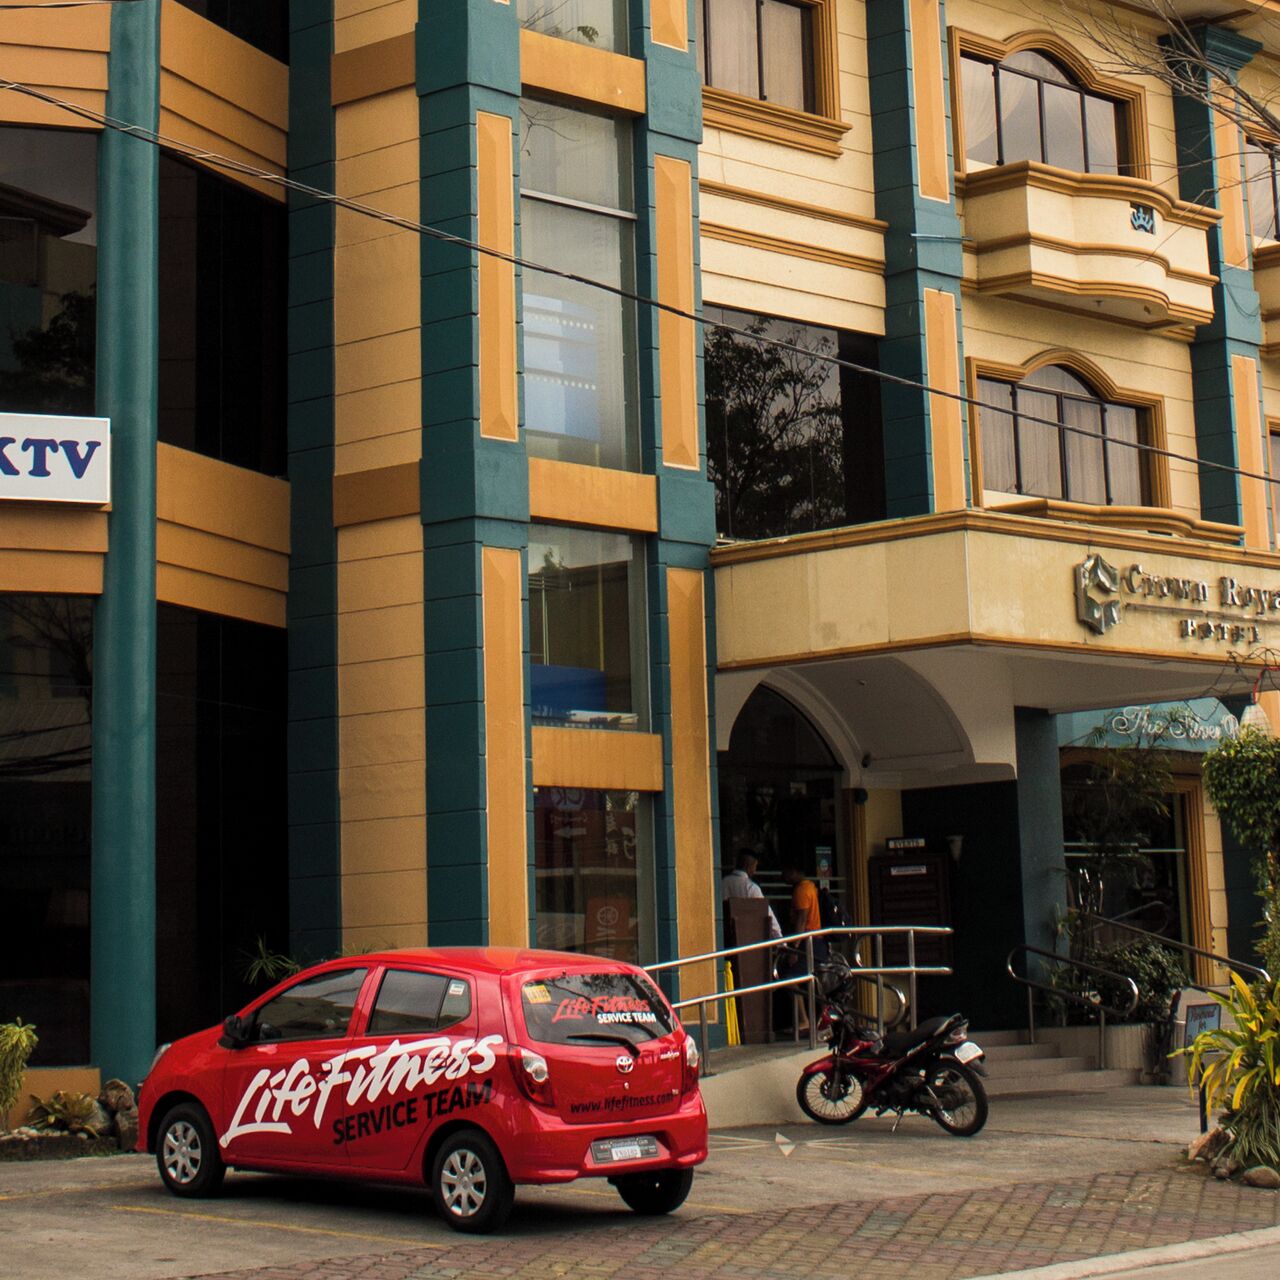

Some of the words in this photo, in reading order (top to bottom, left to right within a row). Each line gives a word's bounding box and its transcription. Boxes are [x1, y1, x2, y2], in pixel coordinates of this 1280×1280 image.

[1122, 564, 1210, 602] Crown
[1112, 705, 1164, 734] The
[596, 1012, 634, 1024] SERVICE
[633, 1011, 657, 1023] TEAM
[331, 1096, 419, 1146] SERVICE
[423, 1077, 494, 1120] TEAM
[570, 1093, 674, 1114] www.lifefitness.com
